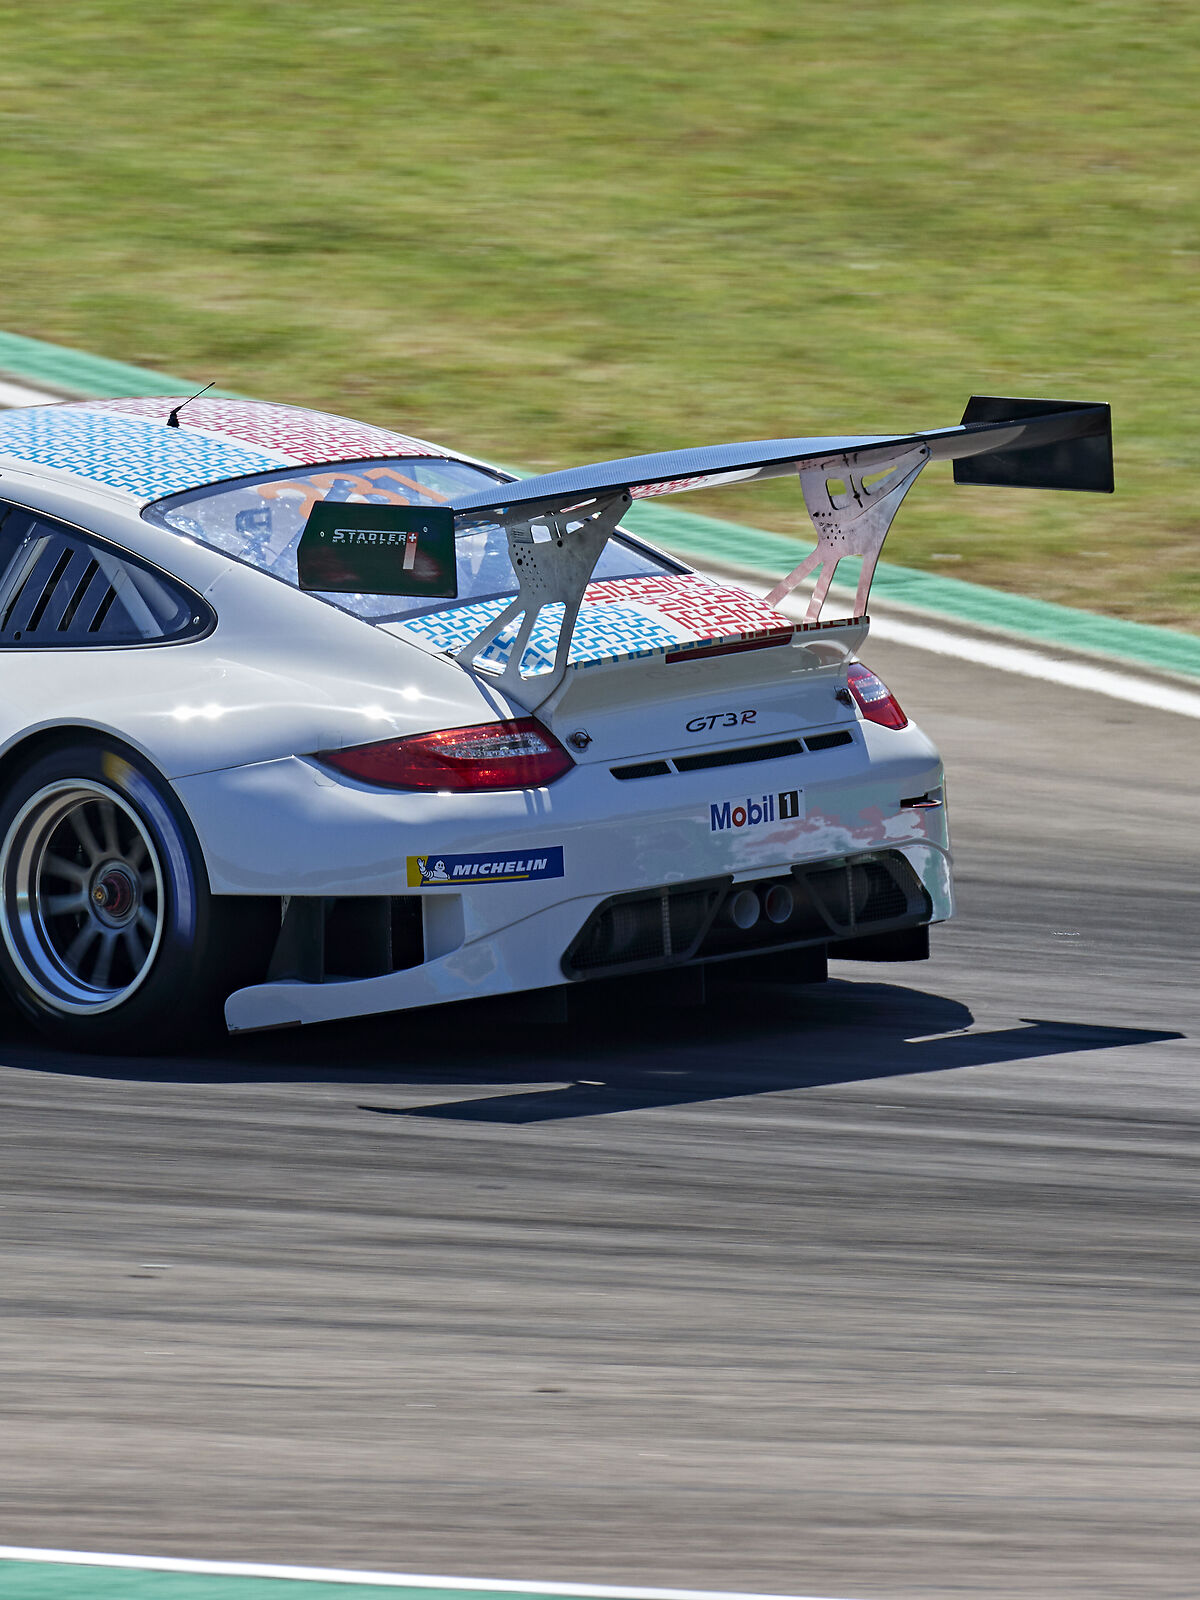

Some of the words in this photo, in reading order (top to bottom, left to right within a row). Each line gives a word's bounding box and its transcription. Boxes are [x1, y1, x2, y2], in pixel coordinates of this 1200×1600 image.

[333, 529, 407, 542] STADLER
[710, 795, 775, 831] Mobil
[452, 858, 548, 876] MICHELIN
